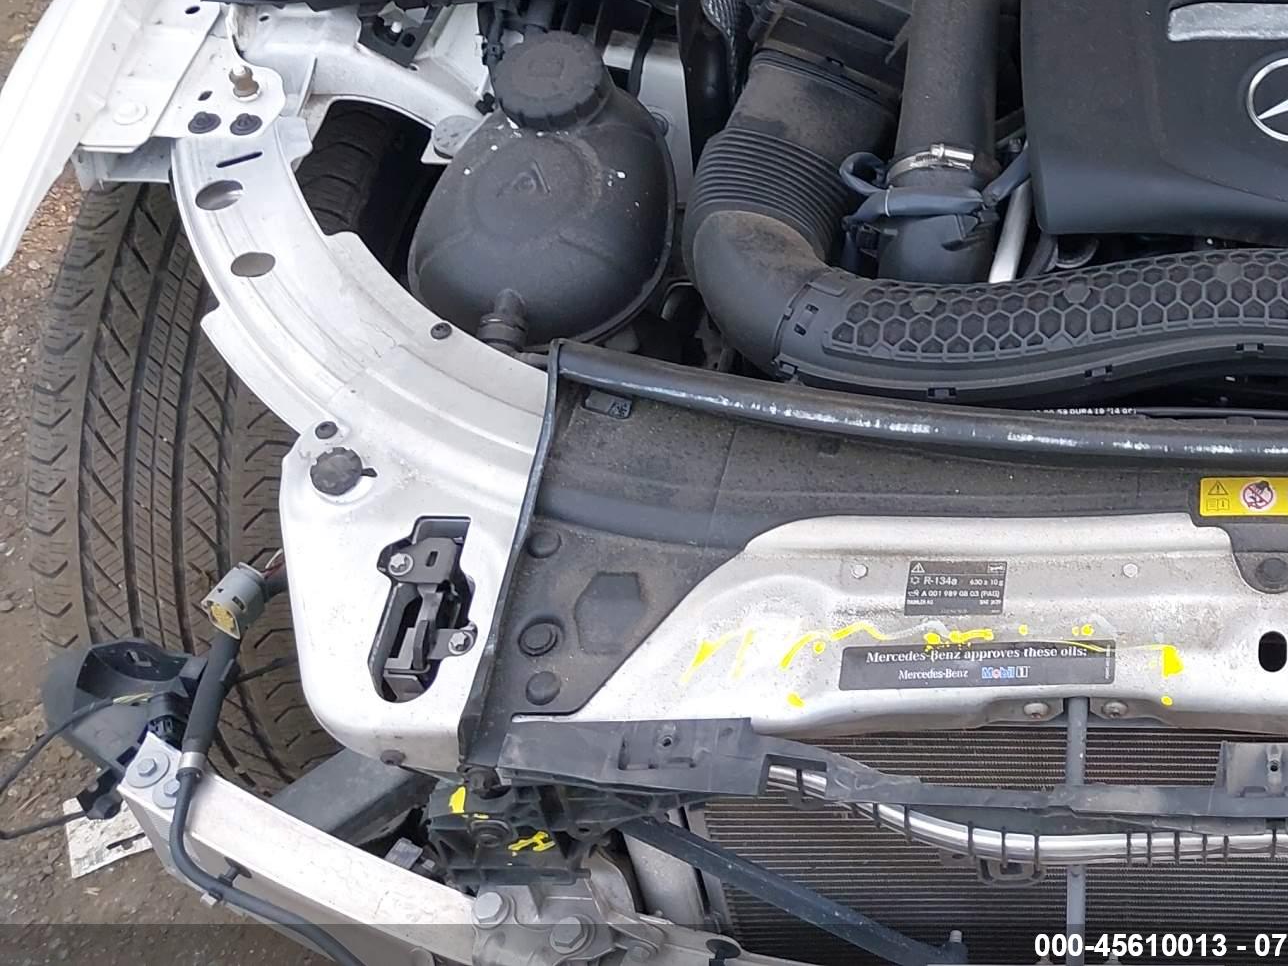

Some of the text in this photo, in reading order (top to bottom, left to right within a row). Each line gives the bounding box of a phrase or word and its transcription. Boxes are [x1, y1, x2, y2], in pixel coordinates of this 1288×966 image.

[924, 576, 958, 586] R-134a
[866, 647, 1088, 663] Mercedes-Benz approves these oils:
[898, 668, 969, 680] Mercedes-Benz
[982, 666, 1016, 679] Mobil
